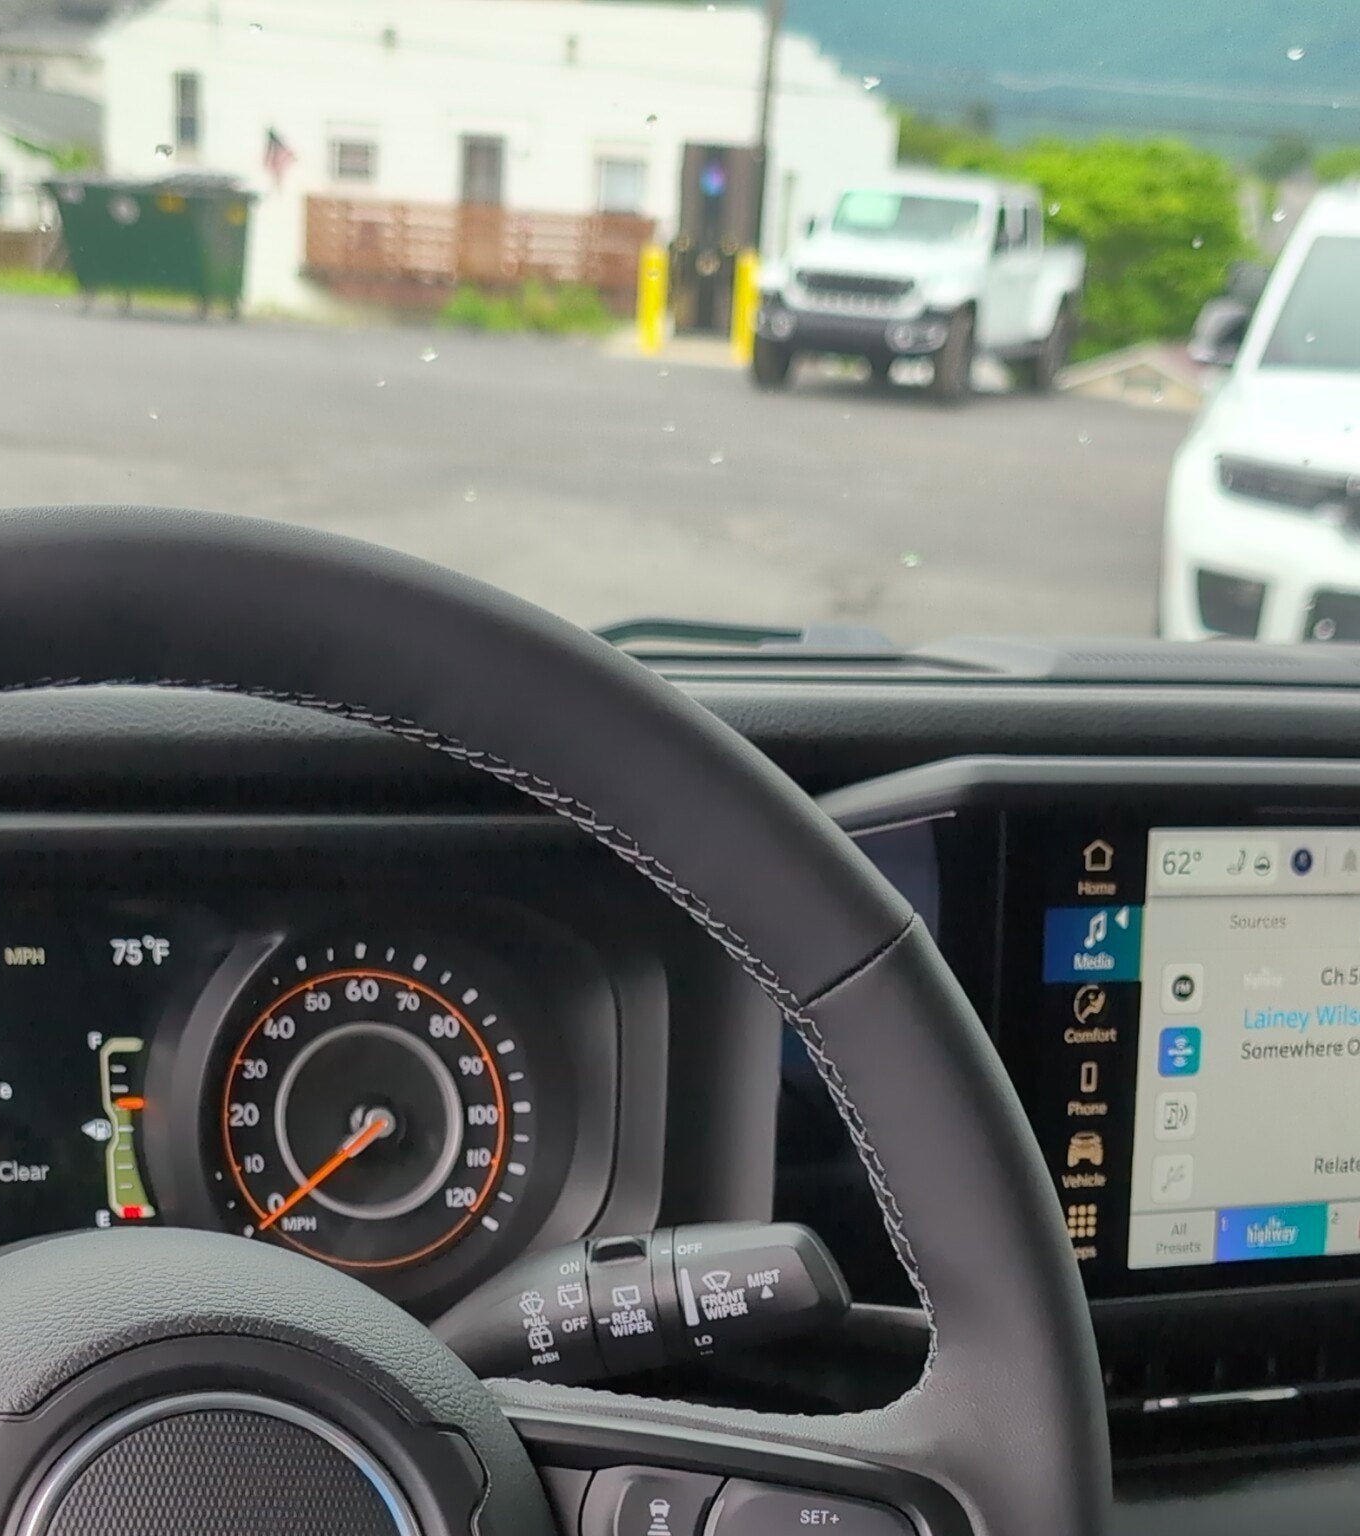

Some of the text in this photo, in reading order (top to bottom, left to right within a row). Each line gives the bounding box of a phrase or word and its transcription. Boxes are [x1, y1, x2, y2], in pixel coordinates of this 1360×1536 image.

[1077, 879, 1117, 897] Home
[1229, 913, 1288, 931] Sources
[4, 947, 46, 966] MPH
[110, 936, 170, 967] 75°F
[1073, 953, 1115, 972] Media
[1320, 967, 1346, 988] Ch
[344, 978, 380, 1003] 60
[304, 991, 332, 1012] 50
[395, 991, 421, 1012] 70
[263, 1015, 296, 1040] 40
[428, 1014, 461, 1039] 80
[1243, 1007, 1311, 1035] Lainey
[88, 1032, 104, 1050] F
[1064, 1026, 1118, 1045] Comfort
[1241, 1042, 1345, 1062] Somewhere
[241, 1058, 269, 1080] 30
[458, 1055, 484, 1076] 90
[228, 1102, 260, 1127] 20
[467, 1104, 499, 1126] 100
[1066, 1100, 1108, 1118] Phone
[244, 1153, 265, 1174] 10
[466, 1147, 491, 1167] 110
[1061, 1172, 1107, 1190] Vehicle
[445, 1186, 477, 1208] 120
[95, 1210, 111, 1228] E
[281, 1215, 317, 1231] MPH
[1170, 1223, 1188, 1238] All
[1246, 1221, 1299, 1248] highway
[677, 1242, 703, 1256] OFF
[1073, 1244, 1097, 1262] pps
[1154, 1239, 1203, 1256] Presets
[559, 1261, 580, 1276] ON
[746, 1268, 781, 1289] MIST
[700, 1287, 746, 1309] FRONT
[611, 1309, 648, 1326] REAR
[703, 1301, 749, 1321] WIPER
[522, 1315, 551, 1330] PULL
[561, 1316, 589, 1334] OFF
[609, 1320, 654, 1338] WIPER
[693, 1334, 714, 1347] LO
[531, 1350, 561, 1366] PUSH
